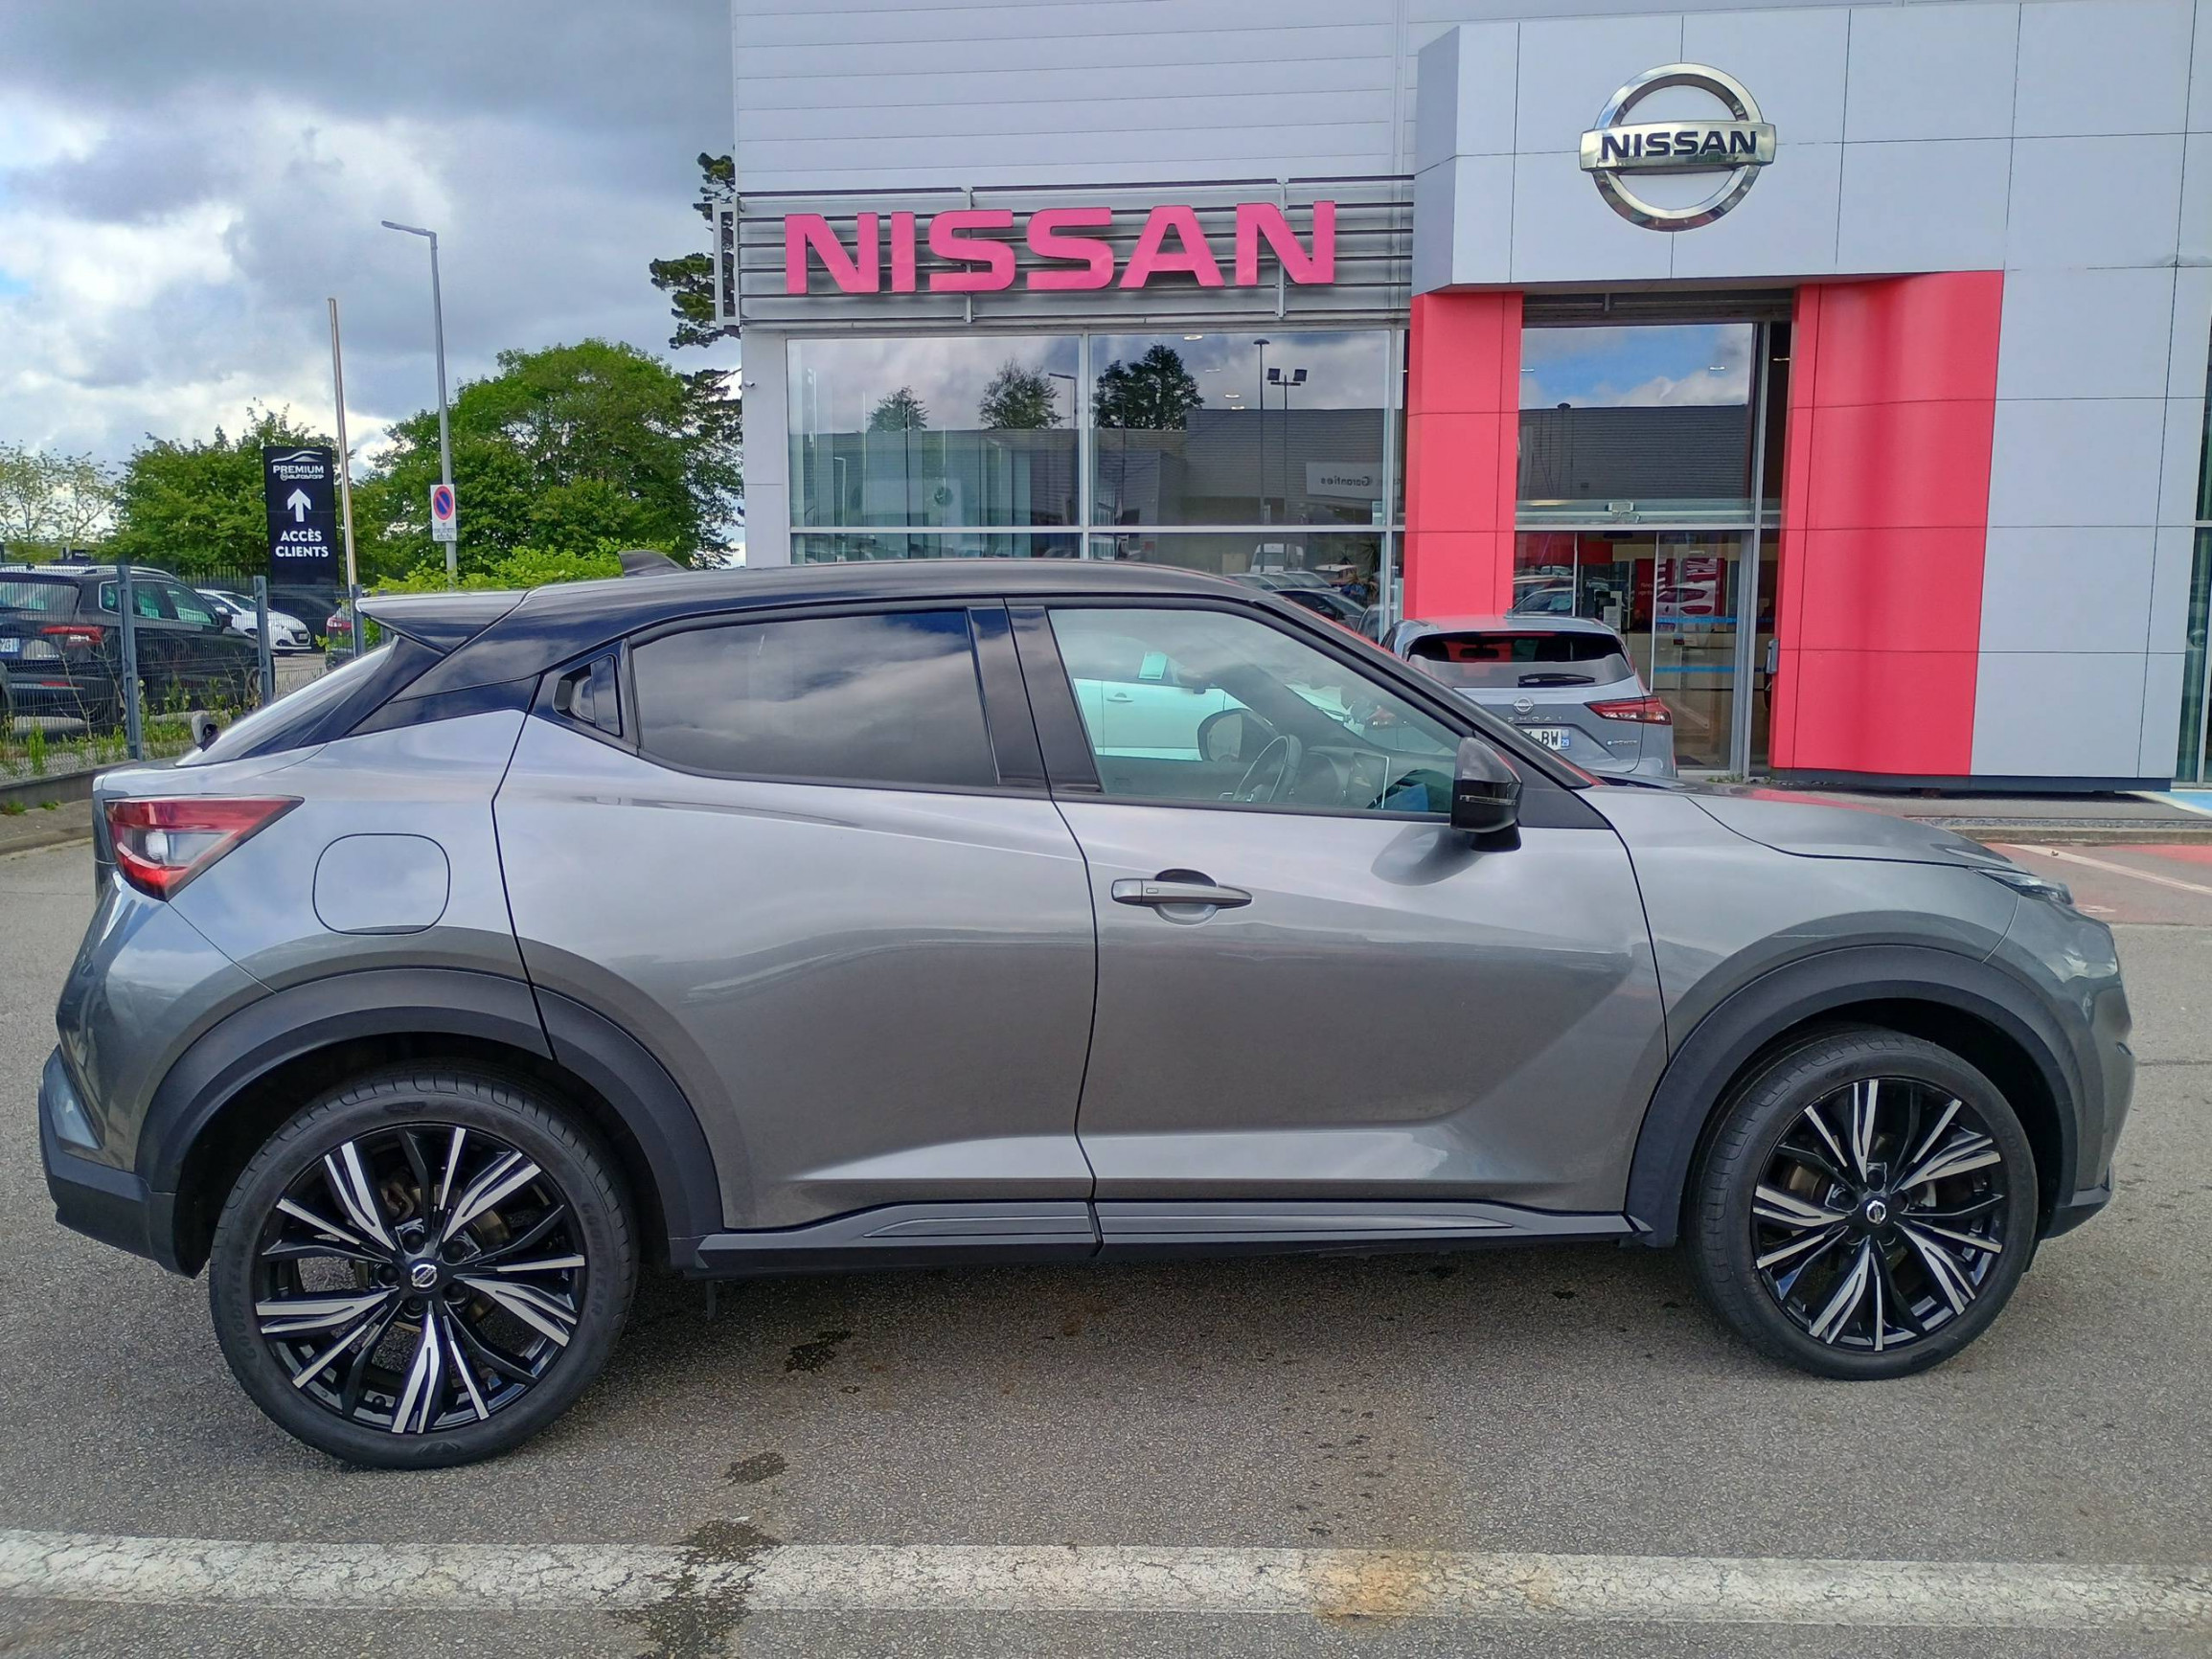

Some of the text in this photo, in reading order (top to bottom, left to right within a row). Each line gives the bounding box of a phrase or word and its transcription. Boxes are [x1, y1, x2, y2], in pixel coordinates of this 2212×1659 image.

[1601, 130, 1758, 160] NISSAN
[785, 200, 1335, 294] NISSAN
[272, 465, 325, 474] PREMIUM
[280, 528, 323, 542] ACCÈS
[275, 545, 329, 557] CLIENTS
[1562, 739, 1570, 747] 29
